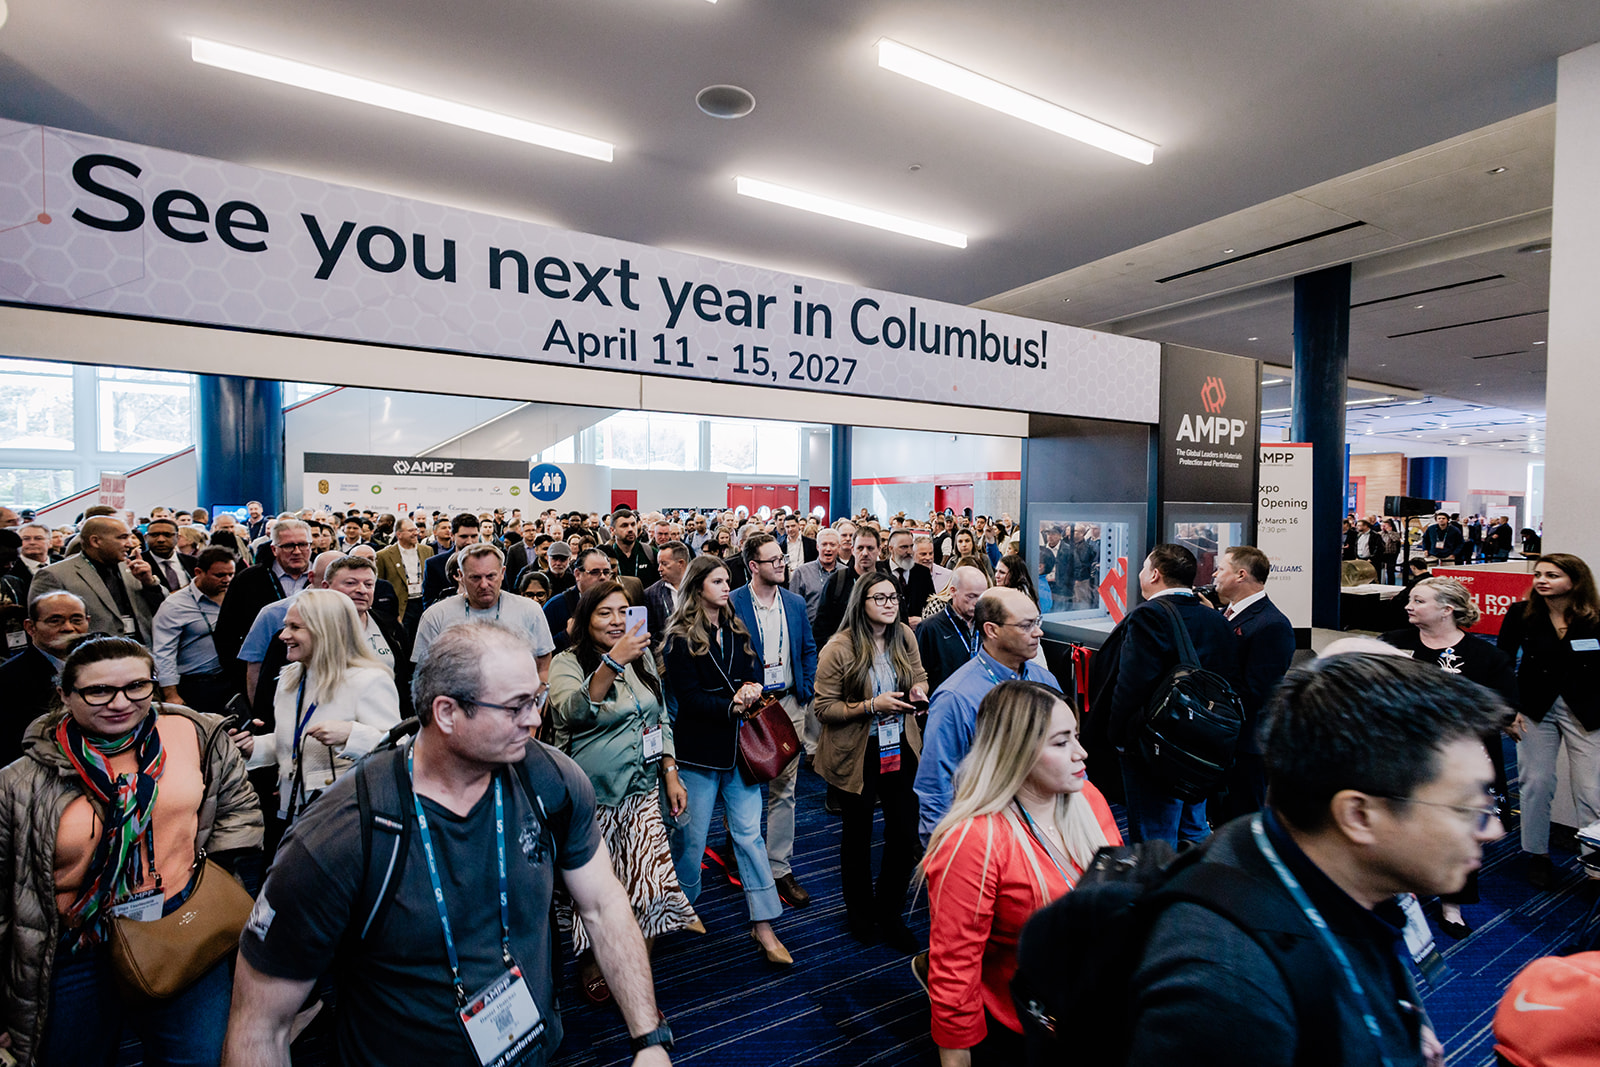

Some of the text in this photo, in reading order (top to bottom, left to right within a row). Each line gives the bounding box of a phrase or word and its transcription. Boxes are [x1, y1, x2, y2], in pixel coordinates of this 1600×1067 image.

[72, 153, 1048, 370] See you next year in Columbus!
[542, 318, 637, 364] April
[652, 333, 694, 368] 11
[732, 343, 778, 381] 15,
[788, 351, 858, 386] 2027
[1176, 414, 1246, 446] AMPP
[1176, 448, 1186, 456] The
[1186, 449, 1201, 457] Global
[1201, 450, 1219, 458] Leaders
[1179, 458, 1203, 466] Protection
[1212, 460, 1239, 468] Performance
[411, 461, 454, 473] AMPP
[1258, 485, 1280, 495] xpo
[1261, 498, 1308, 510] Opening
[484, 978, 511, 1007] AMPP
[505, 1022, 545, 1062] Conference
